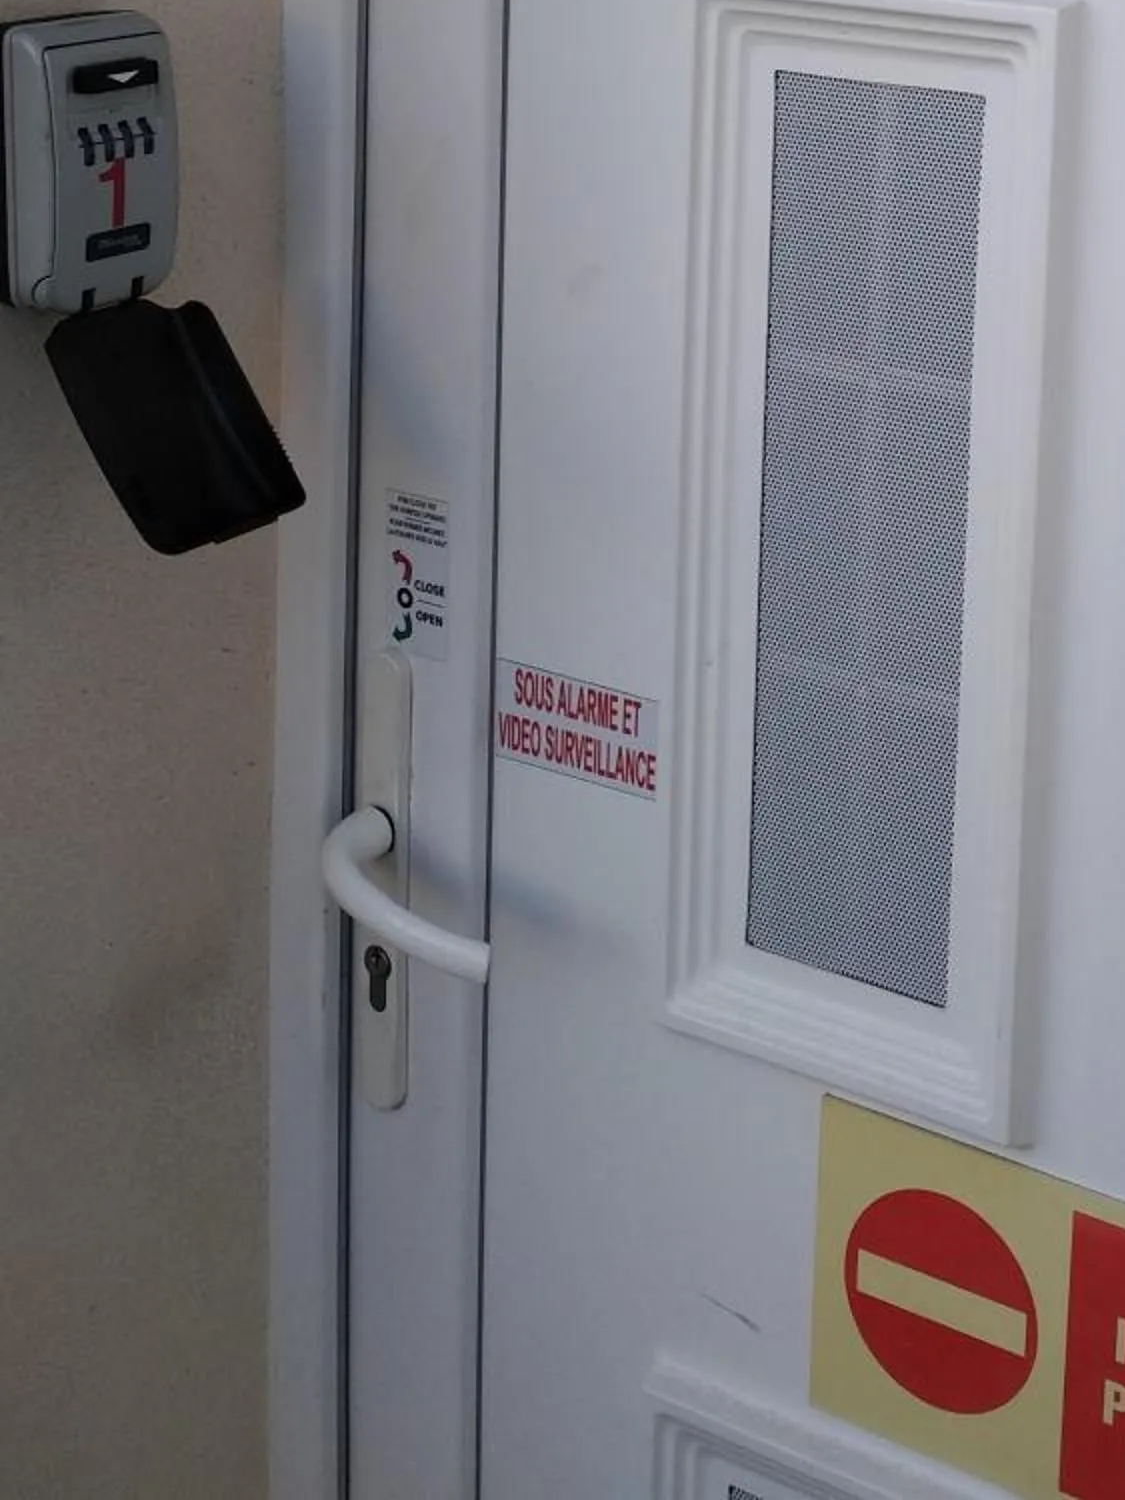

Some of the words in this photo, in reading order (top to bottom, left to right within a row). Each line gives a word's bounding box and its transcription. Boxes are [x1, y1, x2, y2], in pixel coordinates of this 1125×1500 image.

[97, 156, 128, 228] 1
[413, 579, 445, 598] CLOSE
[415, 610, 443, 628] OPEN
[513, 667, 554, 712] SOUS
[556, 680, 619, 732] ALARME
[622, 697, 642, 738] ET
[498, 711, 541, 757] VIDEO
[544, 725, 657, 791] SURVEILLANCE
